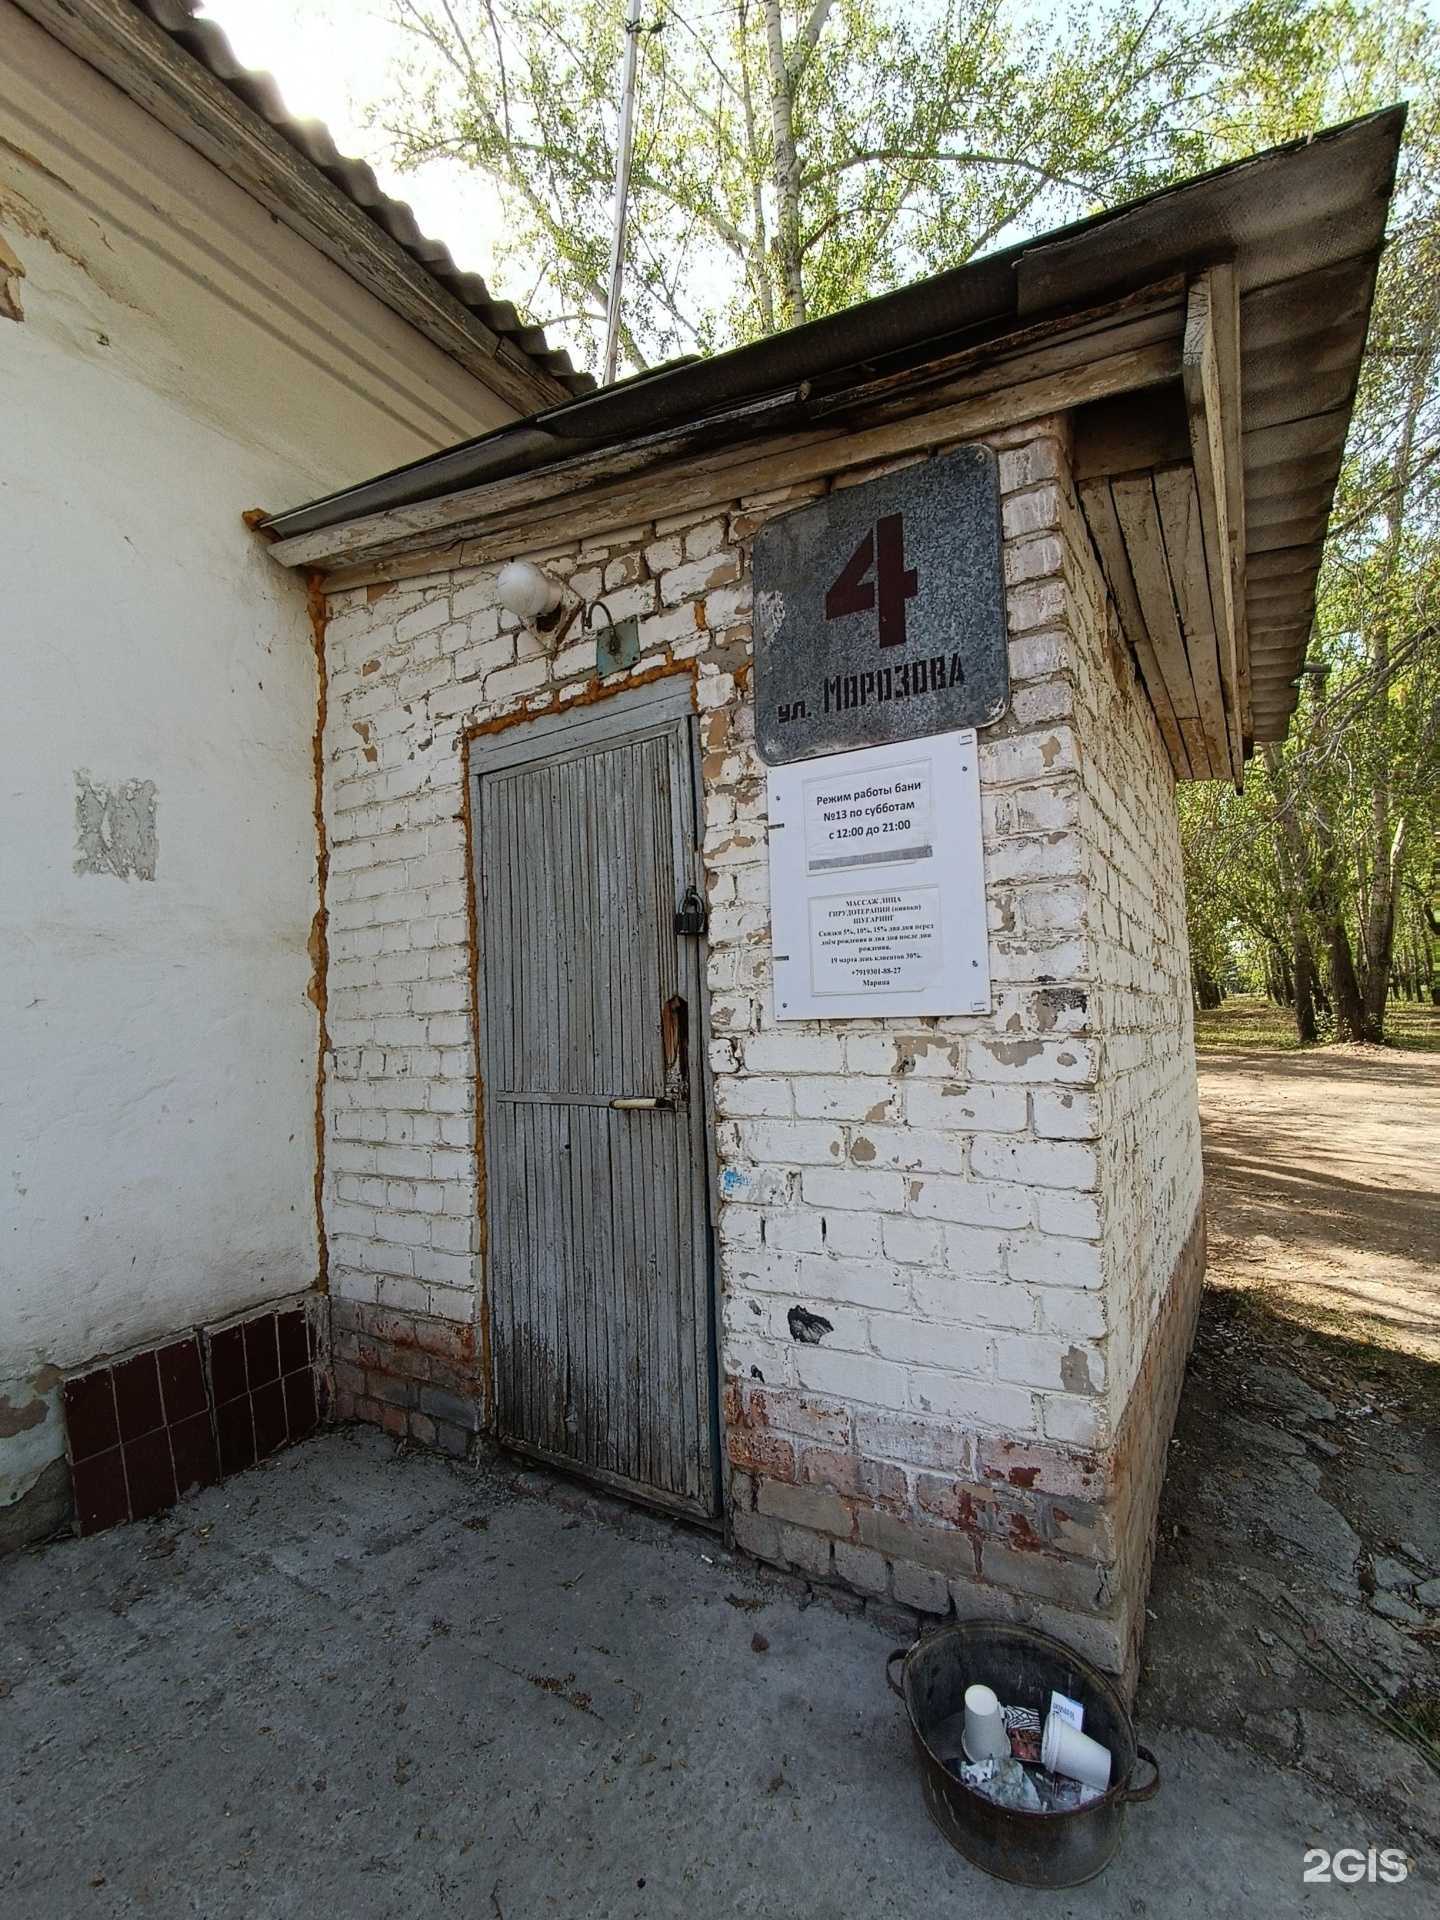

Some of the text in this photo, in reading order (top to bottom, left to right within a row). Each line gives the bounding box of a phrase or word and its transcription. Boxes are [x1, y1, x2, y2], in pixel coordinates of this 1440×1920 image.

[825, 512, 918, 649] 4
[778, 652, 965, 723] ул. МОРОЗОВА
[816, 781, 922, 806] Режим работы бани
[823, 801, 915, 822] №13 по субботам
[828, 819, 911, 840] с 12:00 до 21:00
[846, 898, 880, 907] МАССАЖ
[862, 979, 890, 987] Марина
